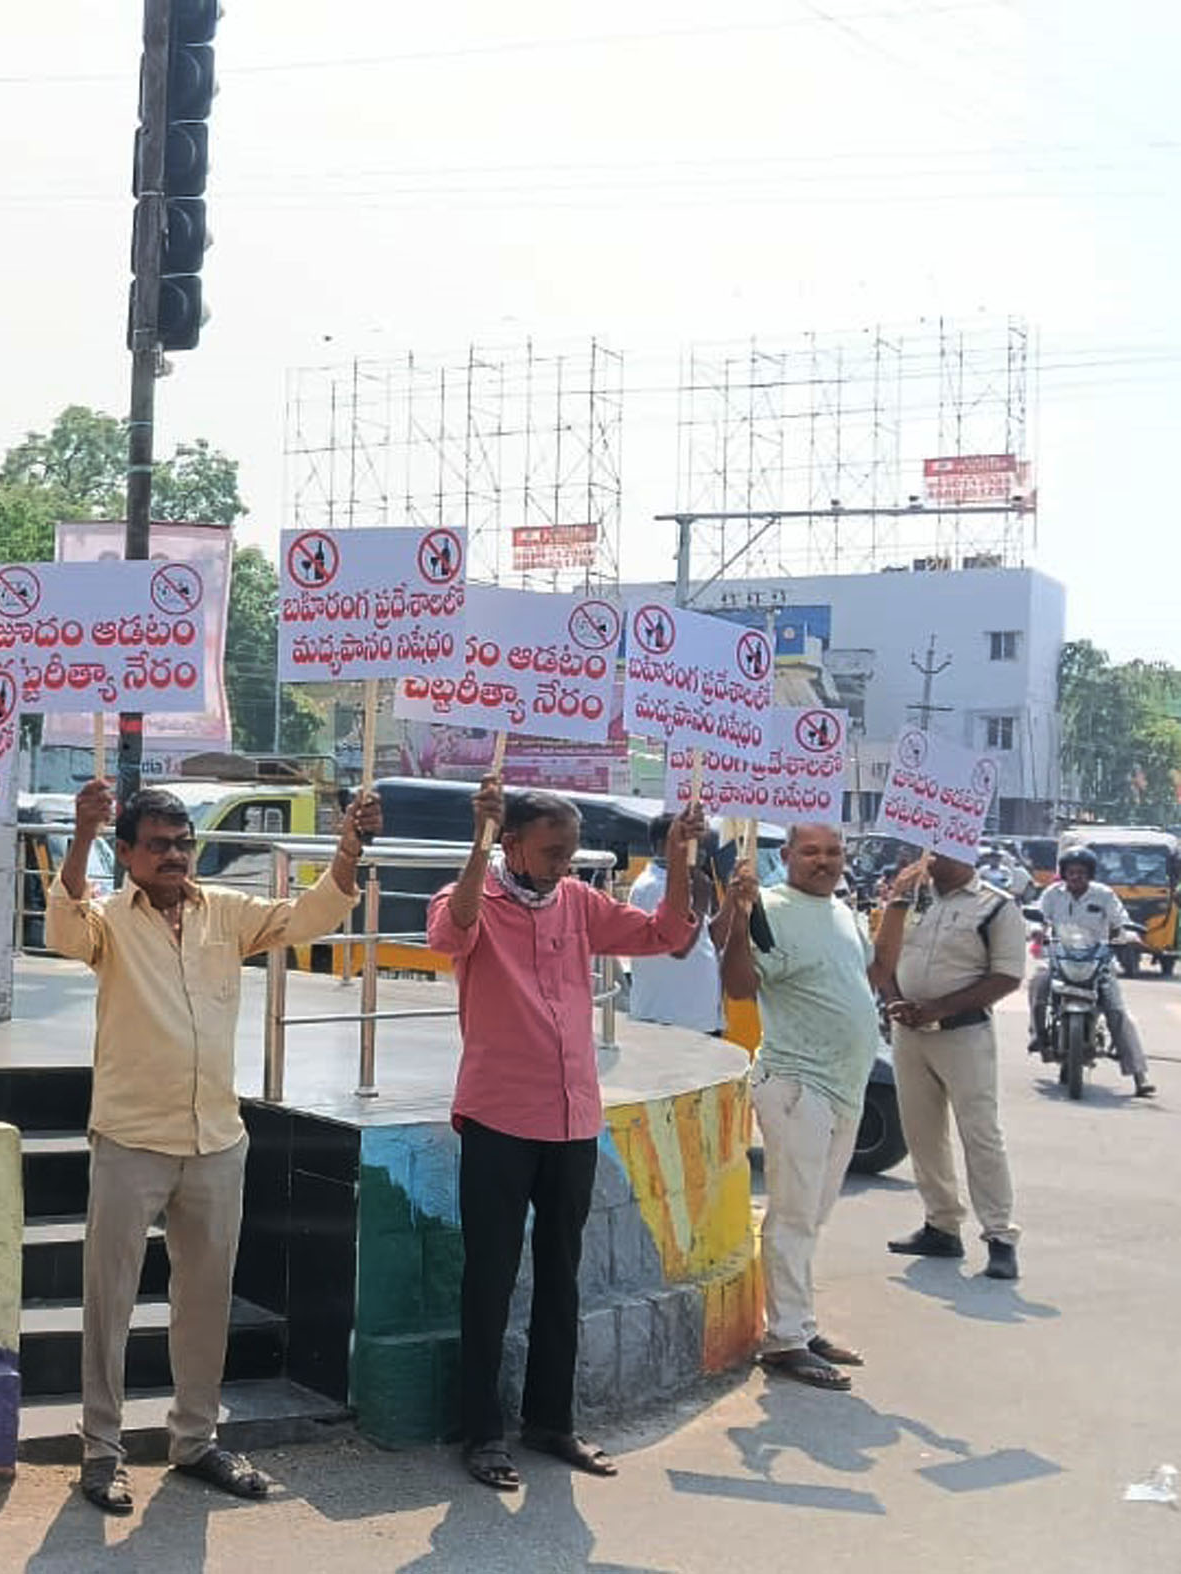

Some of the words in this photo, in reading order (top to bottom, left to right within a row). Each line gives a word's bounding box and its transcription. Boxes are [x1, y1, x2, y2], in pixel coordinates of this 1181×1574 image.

[283, 587, 368, 621] బహిరంగ
[373, 580, 465, 629] ప్రదేశాలలో
[91, 614, 195, 646] ఆడటం
[123, 650, 197, 688] నేరం
[292, 630, 391, 675] మద్యపానం
[398, 625, 454, 664] నిషేధం
[508, 644, 606, 679] ఆడటం
[629, 655, 699, 693] బహిరంగ
[533, 680, 604, 719] నేరం
[717, 711, 762, 748] నిషేధం
[772, 781, 831, 813] నిషేధం
